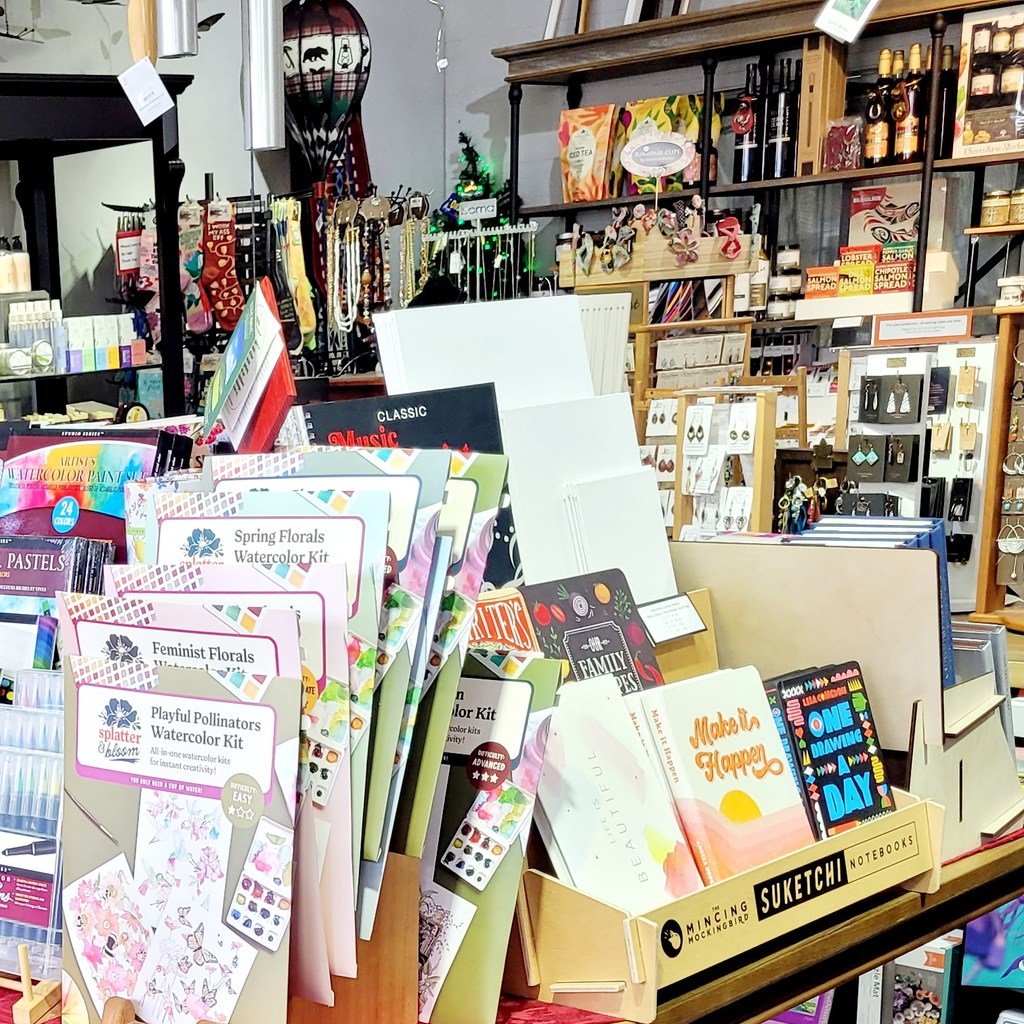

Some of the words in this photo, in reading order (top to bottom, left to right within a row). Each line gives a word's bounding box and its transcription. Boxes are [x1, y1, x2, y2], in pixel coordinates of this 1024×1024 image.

[581, 149, 593, 158] TEA
[841, 253, 872, 261] LOBSTER
[882, 253, 913, 261] SALMON
[875, 266, 908, 275] CHIPOTLE
[875, 273, 908, 282] SALMON
[808, 276, 837, 284] SALMON
[808, 283, 837, 291] SPREAD
[840, 277, 871, 285] SALMON
[840, 284, 871, 292] SPREAD
[874, 281, 907, 290] SPREAD
[377, 406, 427, 423] CLASSIC
[328, 425, 399, 448] Music
[7, 467, 85, 482] WATERCOLOR
[88, 470, 123, 483] PAINT
[60, 501, 74, 517] 24
[54, 515, 74, 527] COLORS
[234, 529, 276, 545] Spring
[279, 528, 325, 544] Florals
[7, 552, 67, 571] PASTELS
[234, 549, 306, 563] Watercolor
[308, 550, 330, 563] Kit
[152, 641, 207, 661] Feminist
[209, 647, 255, 664] Florals
[589, 637, 605, 652] OUR
[577, 651, 628, 681] FAMILY
[151, 707, 191, 724] Playful
[193, 711, 262, 732] Pollinators
[808, 701, 854, 737] ONE
[99, 727, 142, 745] splatter
[151, 725, 221, 747] Watercolor
[223, 734, 244, 751] Kit
[689, 715, 739, 748] Make
[104, 741, 140, 758] bloom
[810, 727, 863, 759] DRAWING
[150, 747, 186, 762] All-in-one
[187, 752, 217, 765] watercolor
[477, 750, 506, 761] DIFFICULTY:
[695, 743, 784, 783] Happen
[161, 758, 182, 771] instant
[183, 761, 217, 776] creativity!
[472, 758, 506, 772] ADVANCED
[836, 755, 851, 777] A
[232, 793, 253, 804] EASY
[823, 771, 874, 821] DAY
[760, 855, 844, 914] SUKETCHI
[849, 834, 914, 870] NOTEBOOKS
[686, 900, 749, 935] MINCING
[687, 913, 750, 945] MOCKINGBIRD
